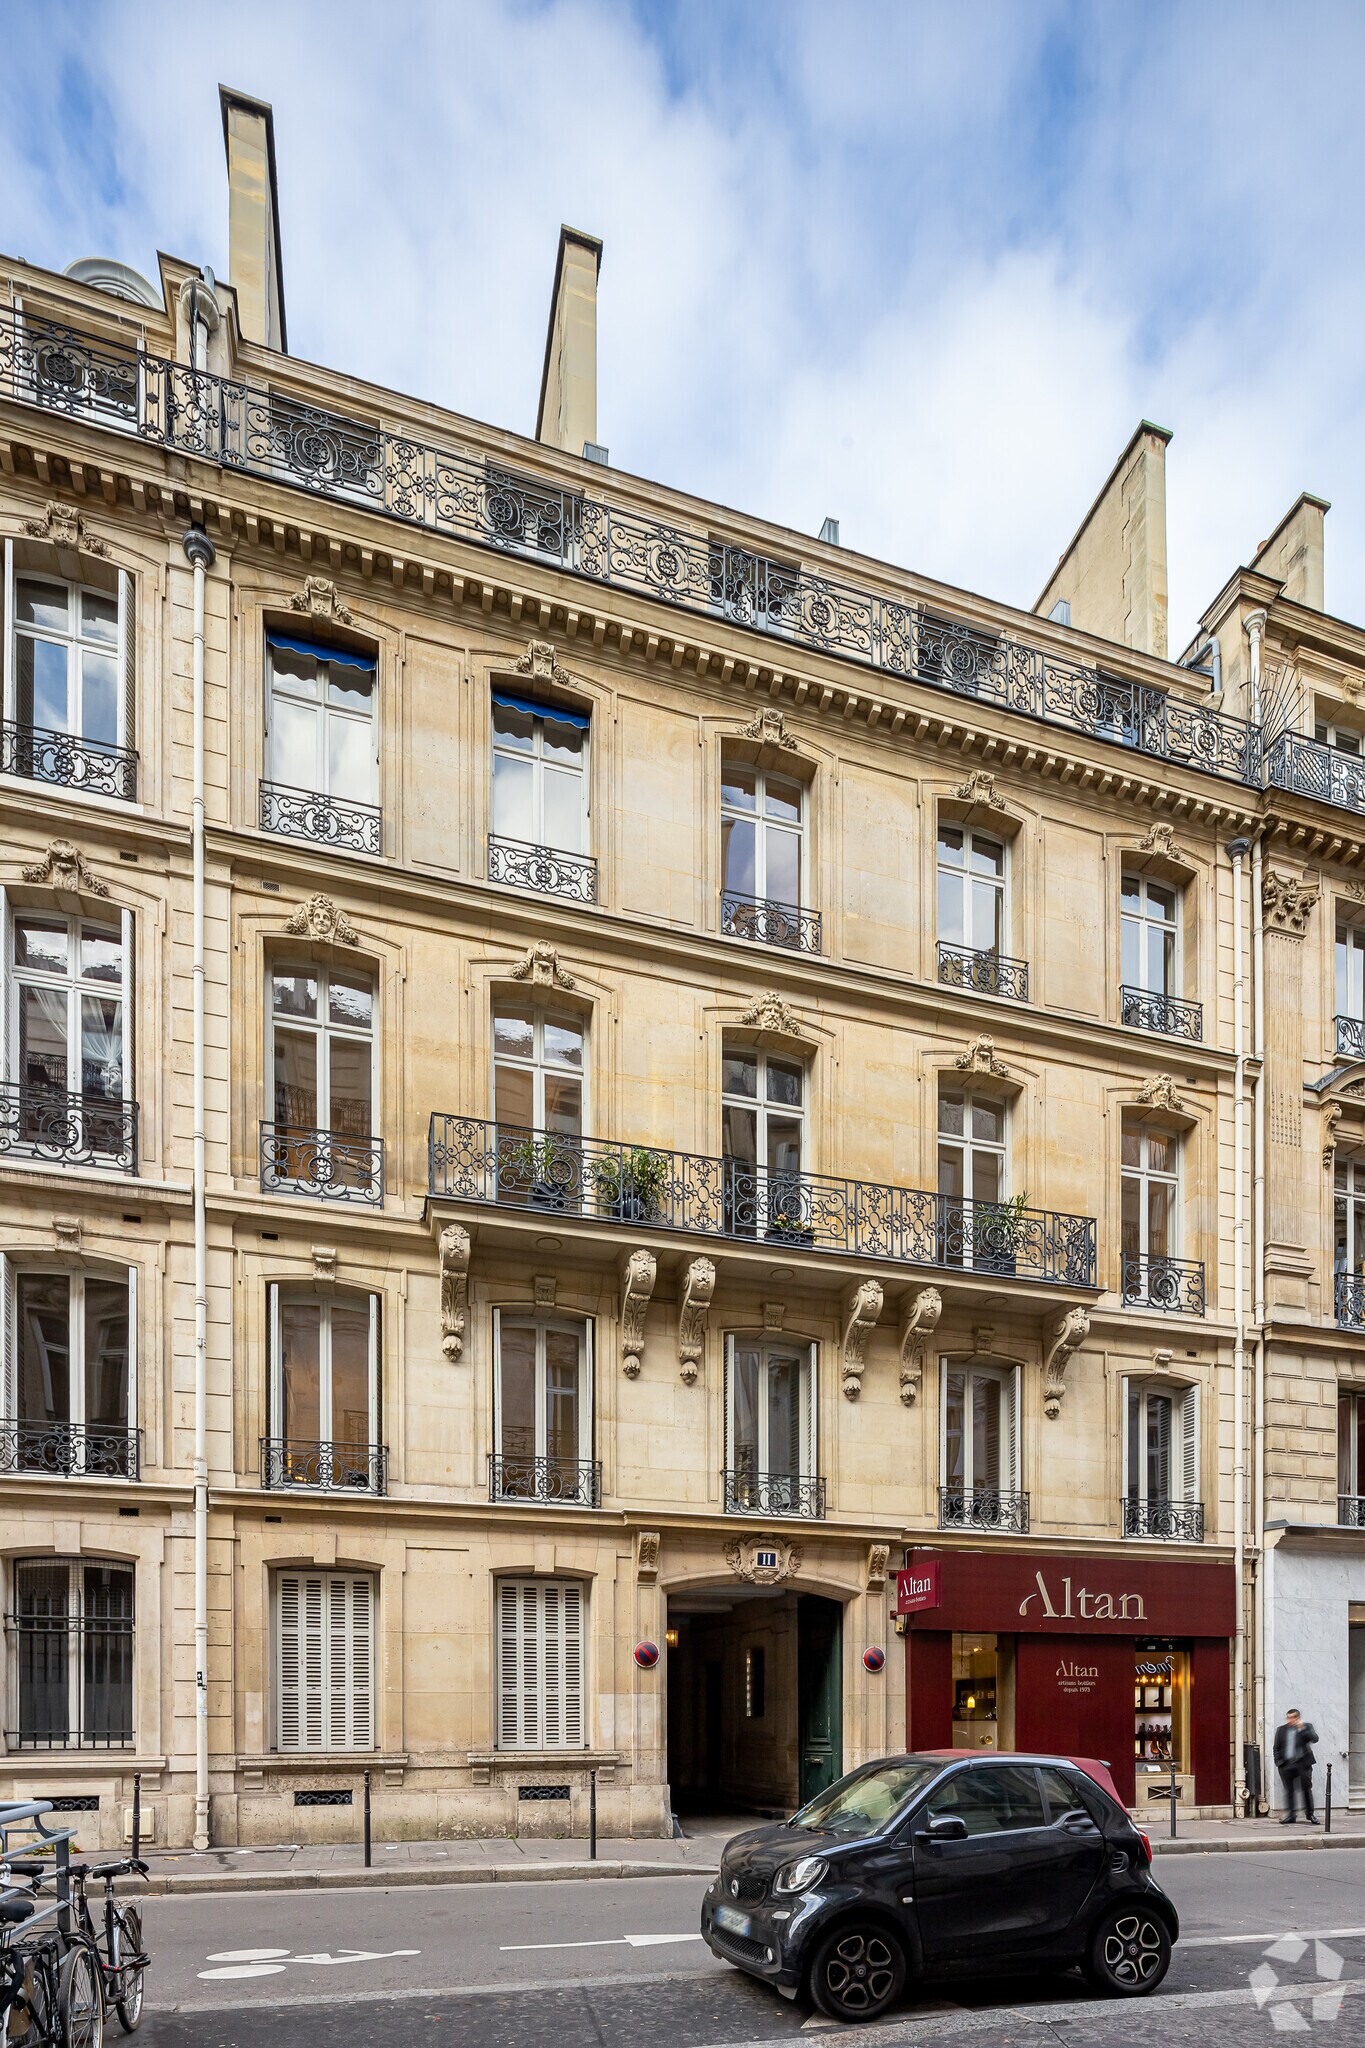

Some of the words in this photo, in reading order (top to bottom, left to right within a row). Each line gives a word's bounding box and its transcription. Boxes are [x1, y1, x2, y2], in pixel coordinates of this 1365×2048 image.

[900, 1576, 931, 1598] Altan
[1018, 1570, 1148, 1620] Altan
[1055, 1660, 1099, 1677] Altan
